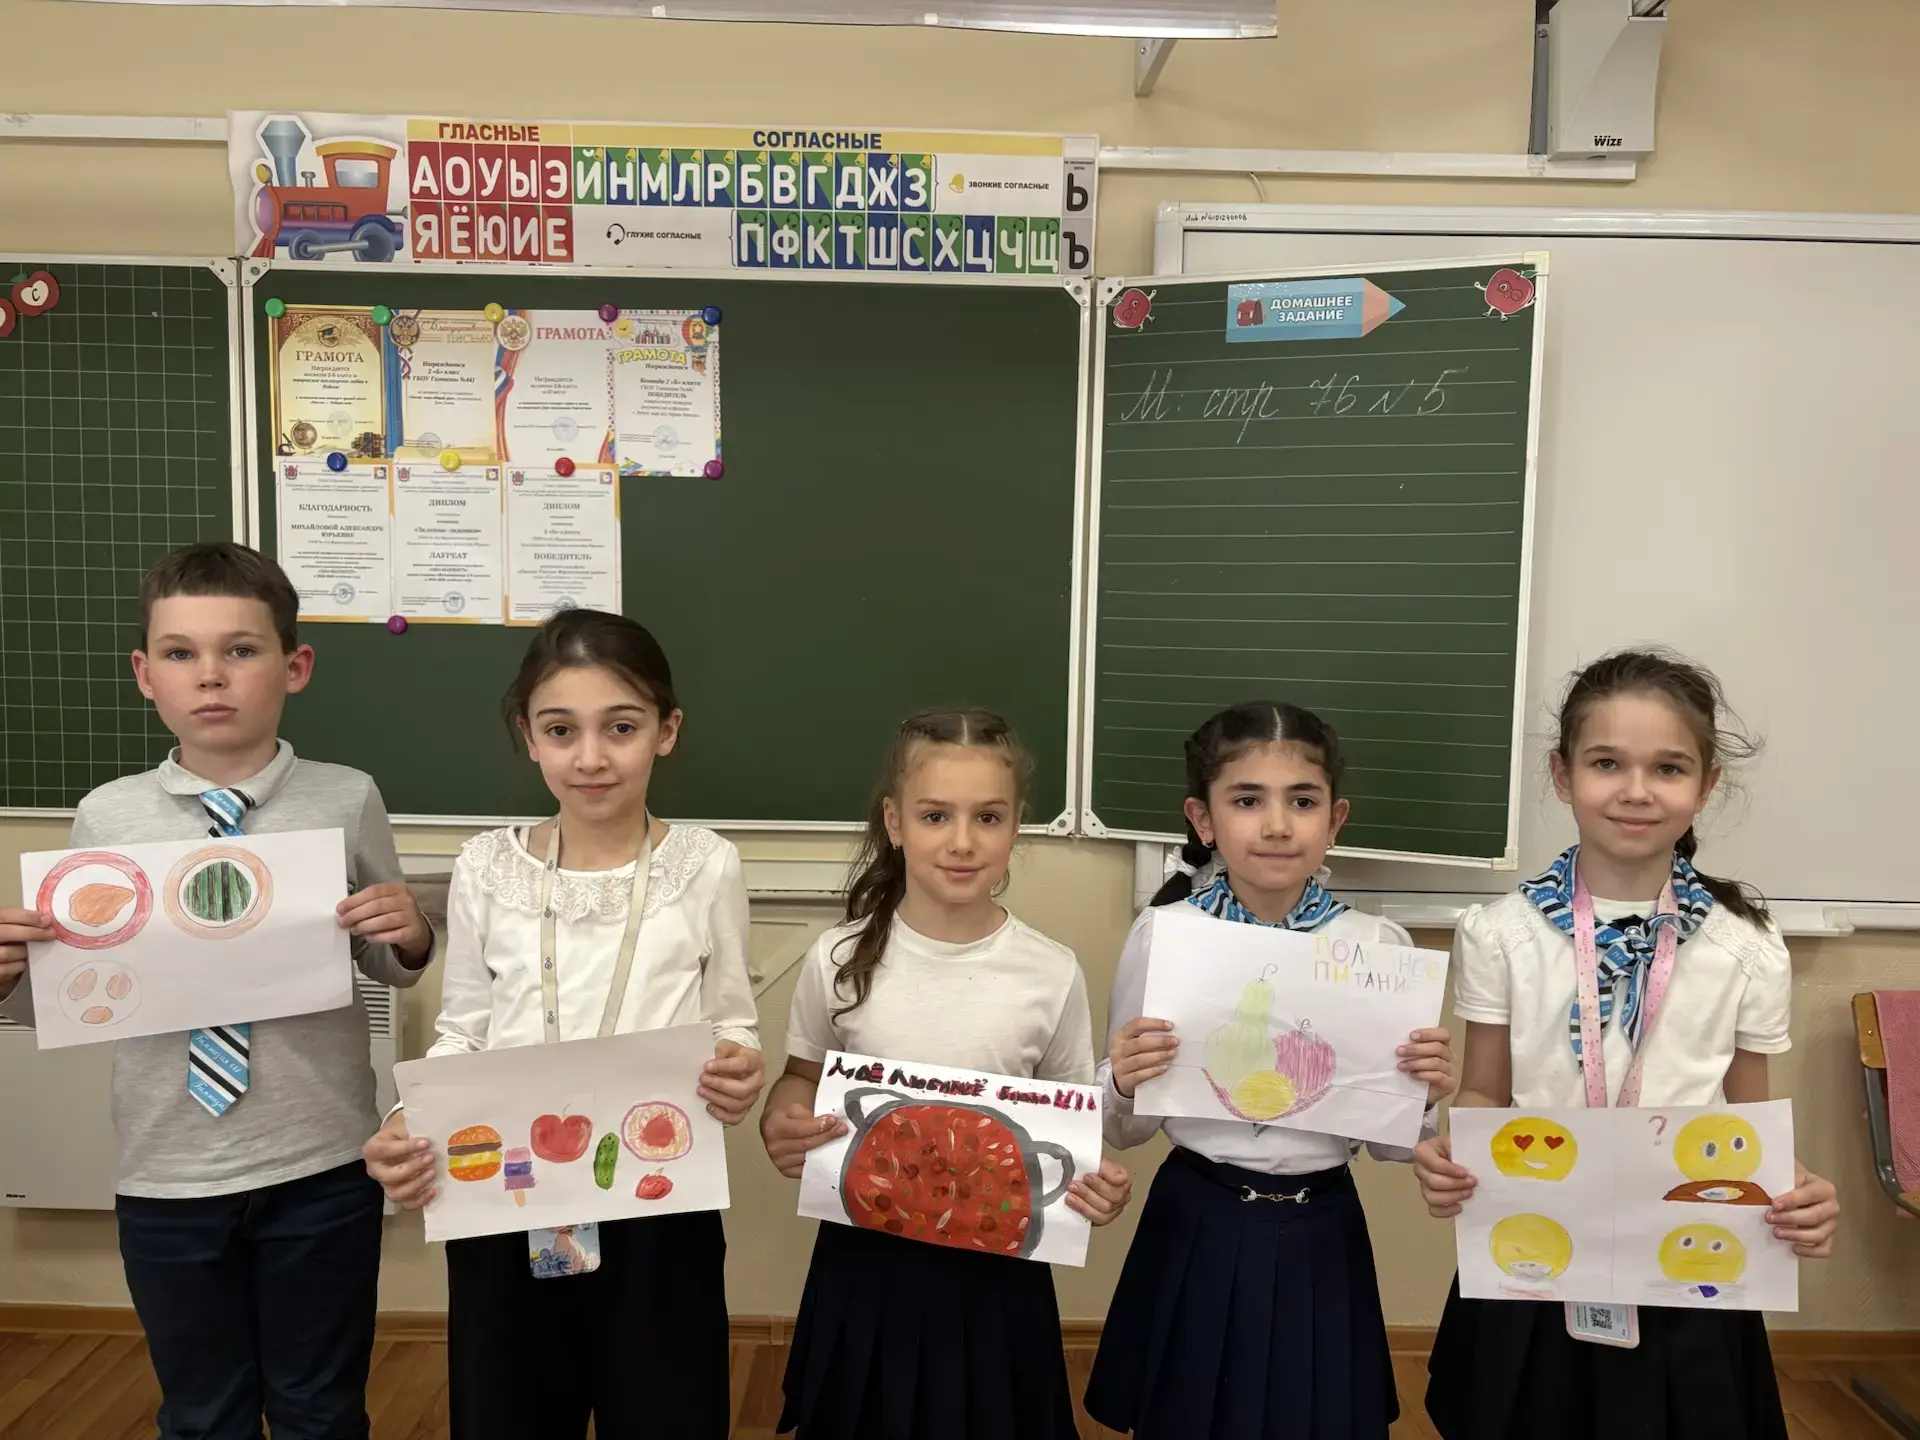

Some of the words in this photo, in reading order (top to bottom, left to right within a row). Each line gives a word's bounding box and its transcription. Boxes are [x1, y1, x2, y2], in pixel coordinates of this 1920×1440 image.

[439, 123, 541, 142] ГЛАСНЫЕ
[752, 130, 883, 150] СОГЛАСНЫЕ
[968, 181, 1003, 189] ЗВОНКИЕ
[1004, 182, 1049, 190] СОГЛАСНЫЕ
[1067, 172, 1089, 213] Ь
[626, 231, 654, 239] ГЛУХИЕ
[656, 231, 702, 240] СОГЛАСНЫЕ
[1062, 231, 1090, 270] Ъ
[1270, 294, 1354, 310] ДОМАШНЕЕ
[1278, 309, 1345, 323] ЗАДАНИЕ
[536, 327, 605, 341] ГРАМОТА
[295, 351, 365, 363] ГРАМОТА
[616, 348, 688, 365] ГРАМОТА
[645, 363, 688, 371] Награждается
[1309, 373, 1360, 415] 76
[299, 503, 373, 512] БЛАГОДАРНОСТЬ
[428, 499, 466, 507] ДИПЛОМ
[291, 523, 338, 531] МИХАЙЛОВОЙ
[534, 553, 592, 561] ПОБЕДИТЕЛЬ
